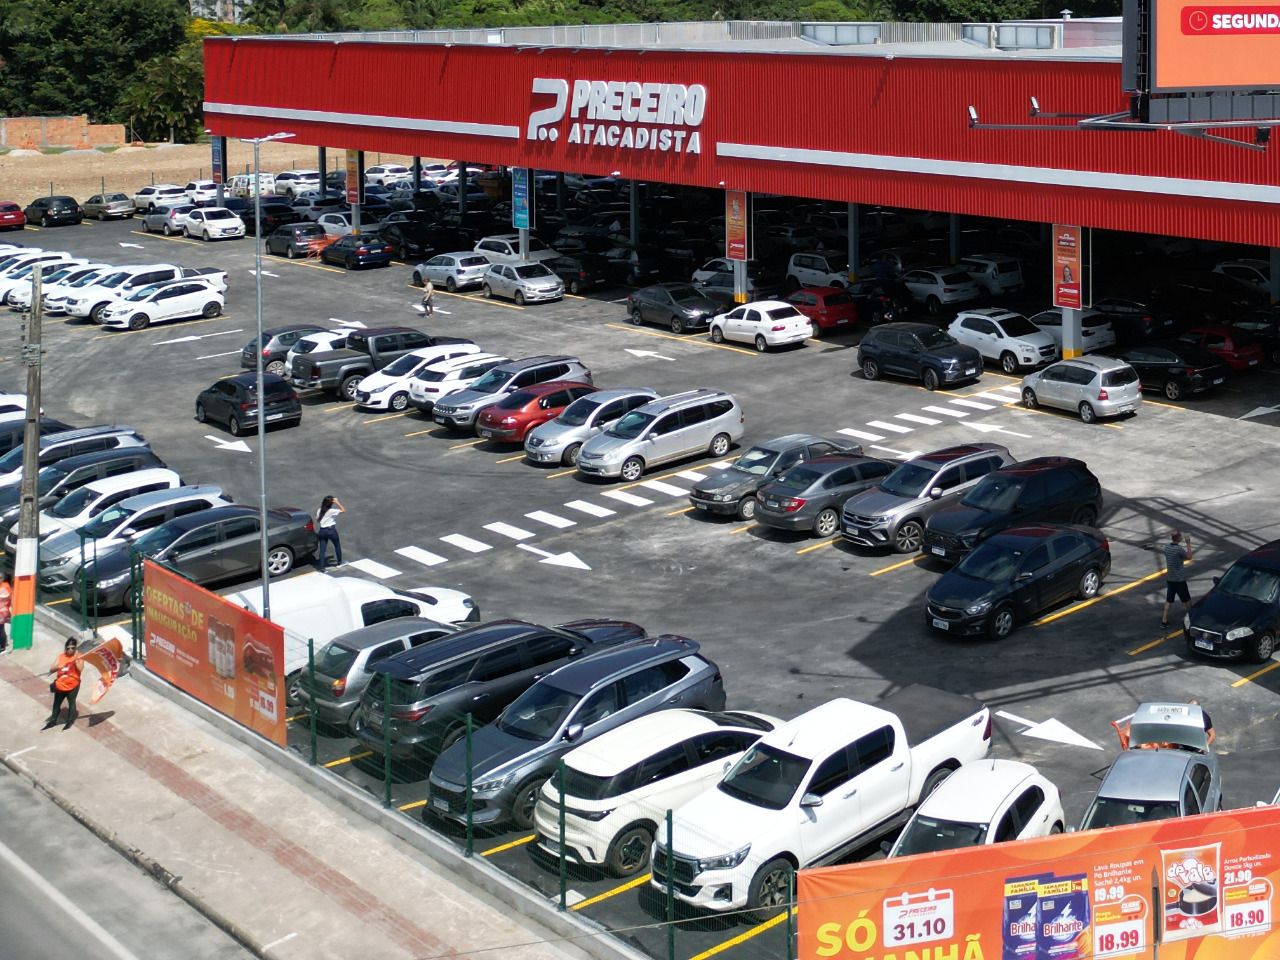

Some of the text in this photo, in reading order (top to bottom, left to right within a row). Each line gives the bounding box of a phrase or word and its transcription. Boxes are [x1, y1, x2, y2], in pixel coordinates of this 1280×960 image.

[571, 80, 706, 126] PRECEIRO
[568, 123, 701, 154] ATACADISTA
[146, 586, 203, 629] OFERTAS DE
[146, 605, 197, 643] INAUGURAÇÃO
[1104, 869, 1132, 877] Brilhante
[1011, 886, 1036, 894] FAMÍLIA
[1044, 887, 1068, 895] FAMÍLIA
[1044, 921, 1083, 937] Brilhante
[1230, 909, 1264, 927] 18,90
[816, 909, 877, 957] SÓ
[893, 918, 946, 941] 31.10
[1098, 930, 1139, 952] 18,99
